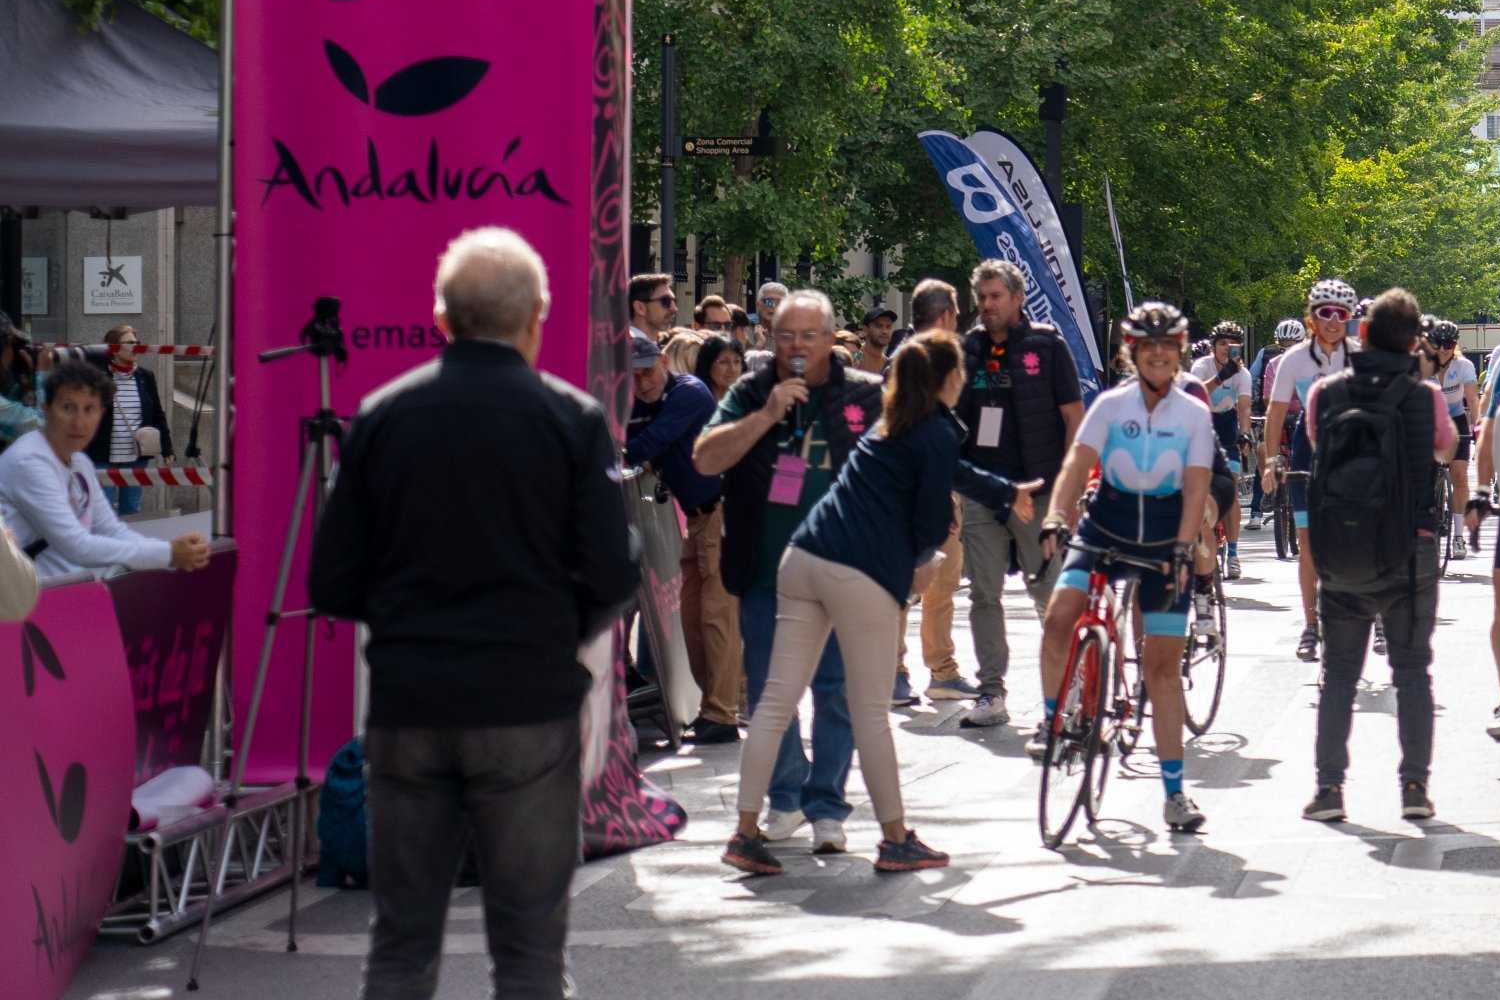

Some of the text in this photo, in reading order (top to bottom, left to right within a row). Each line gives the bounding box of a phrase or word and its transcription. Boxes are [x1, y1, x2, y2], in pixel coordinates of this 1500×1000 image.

[696, 138, 753, 146] Zona Comercial
[696, 147, 750, 156] Shopping Area
[257, 136, 573, 210] Andalucía
[351, 324, 449, 349] emas
